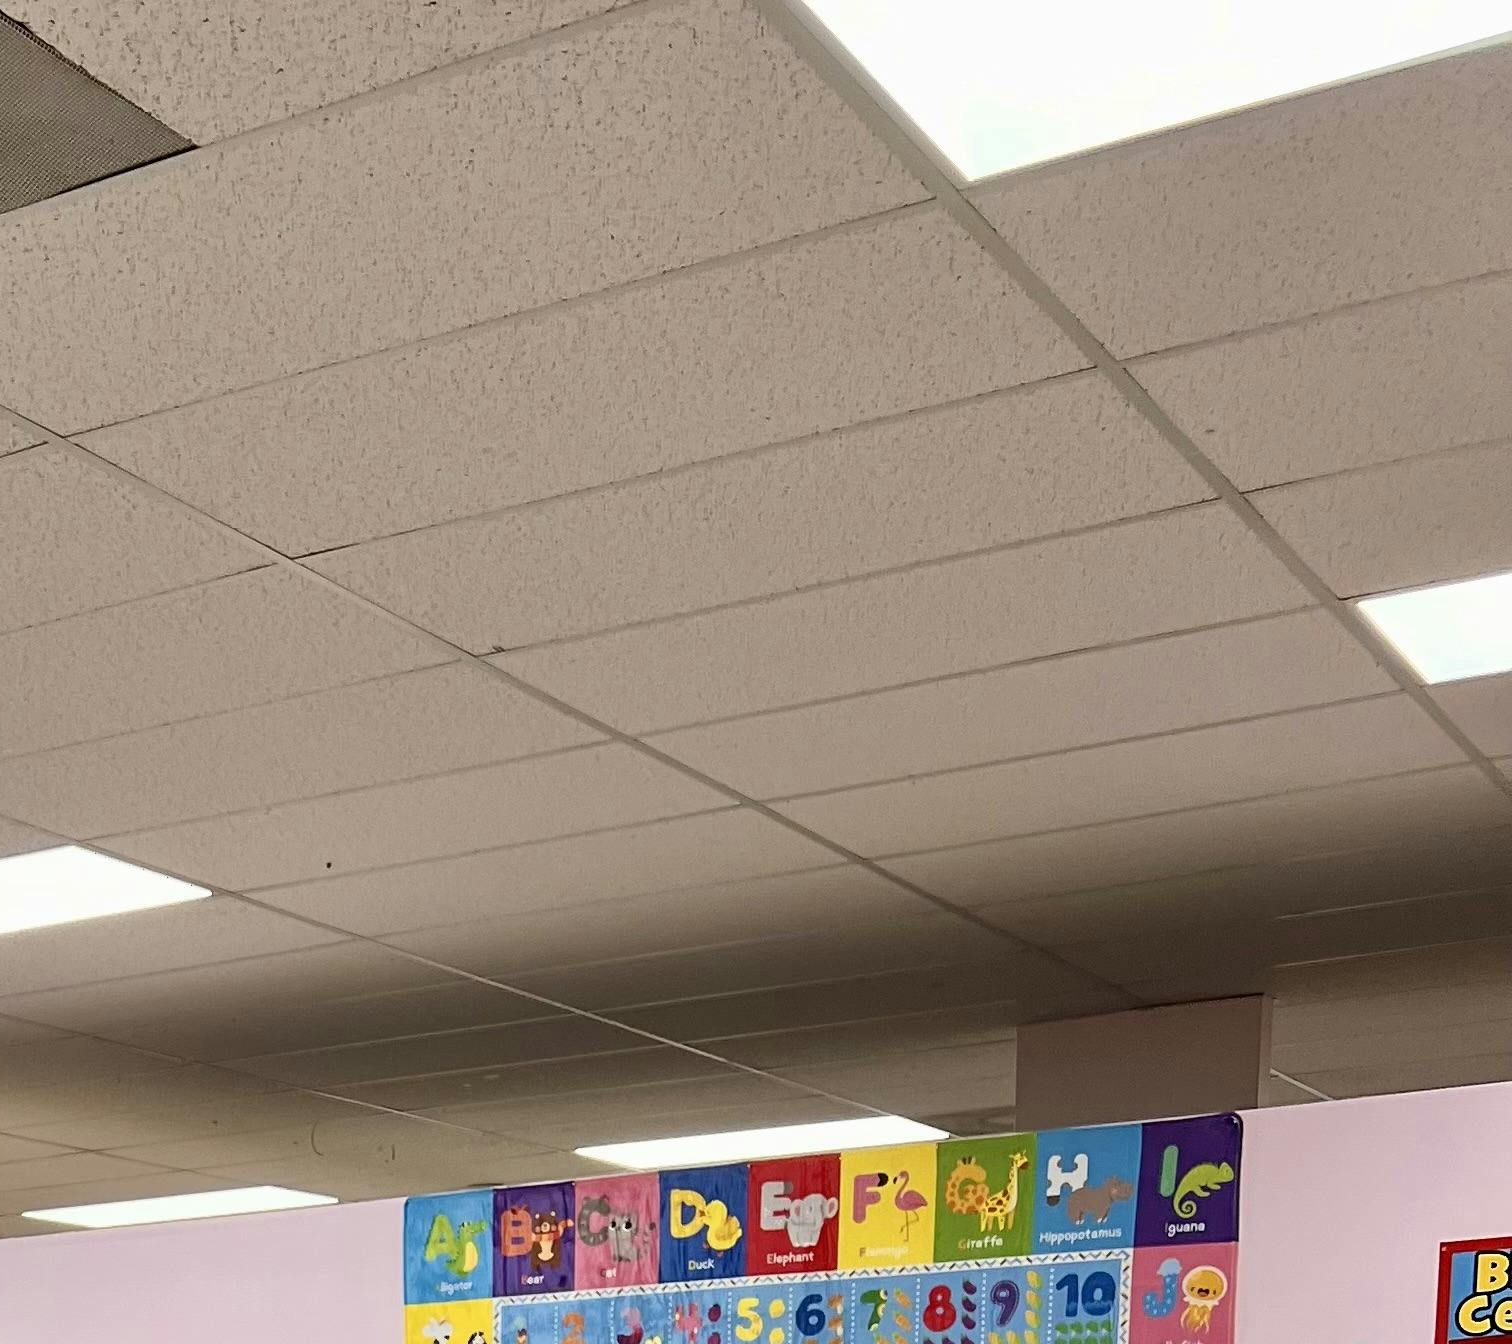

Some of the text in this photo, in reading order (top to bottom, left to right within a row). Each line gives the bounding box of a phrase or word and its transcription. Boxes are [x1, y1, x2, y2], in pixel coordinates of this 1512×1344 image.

[760, 1181, 793, 1230] E
[853, 1172, 889, 1224] F
[946, 1156, 988, 1214] G
[1046, 1154, 1089, 1206] H
[500, 1206, 533, 1257] B
[577, 1195, 611, 1247] C
[670, 1189, 707, 1238] D
[1040, 1228, 1122, 1246] Hippopotamus
[1165, 1222, 1206, 1237] Iguana
[688, 1259, 715, 1271] Duck
[767, 1251, 814, 1266] Elephant
[735, 1298, 763, 1342] 5
[795, 1294, 826, 1336] 6
[922, 1284, 956, 1332] 8
[989, 1279, 1020, 1327] 9
[1055, 1271, 1116, 1318] 10
[1143, 1259, 1182, 1318] J
